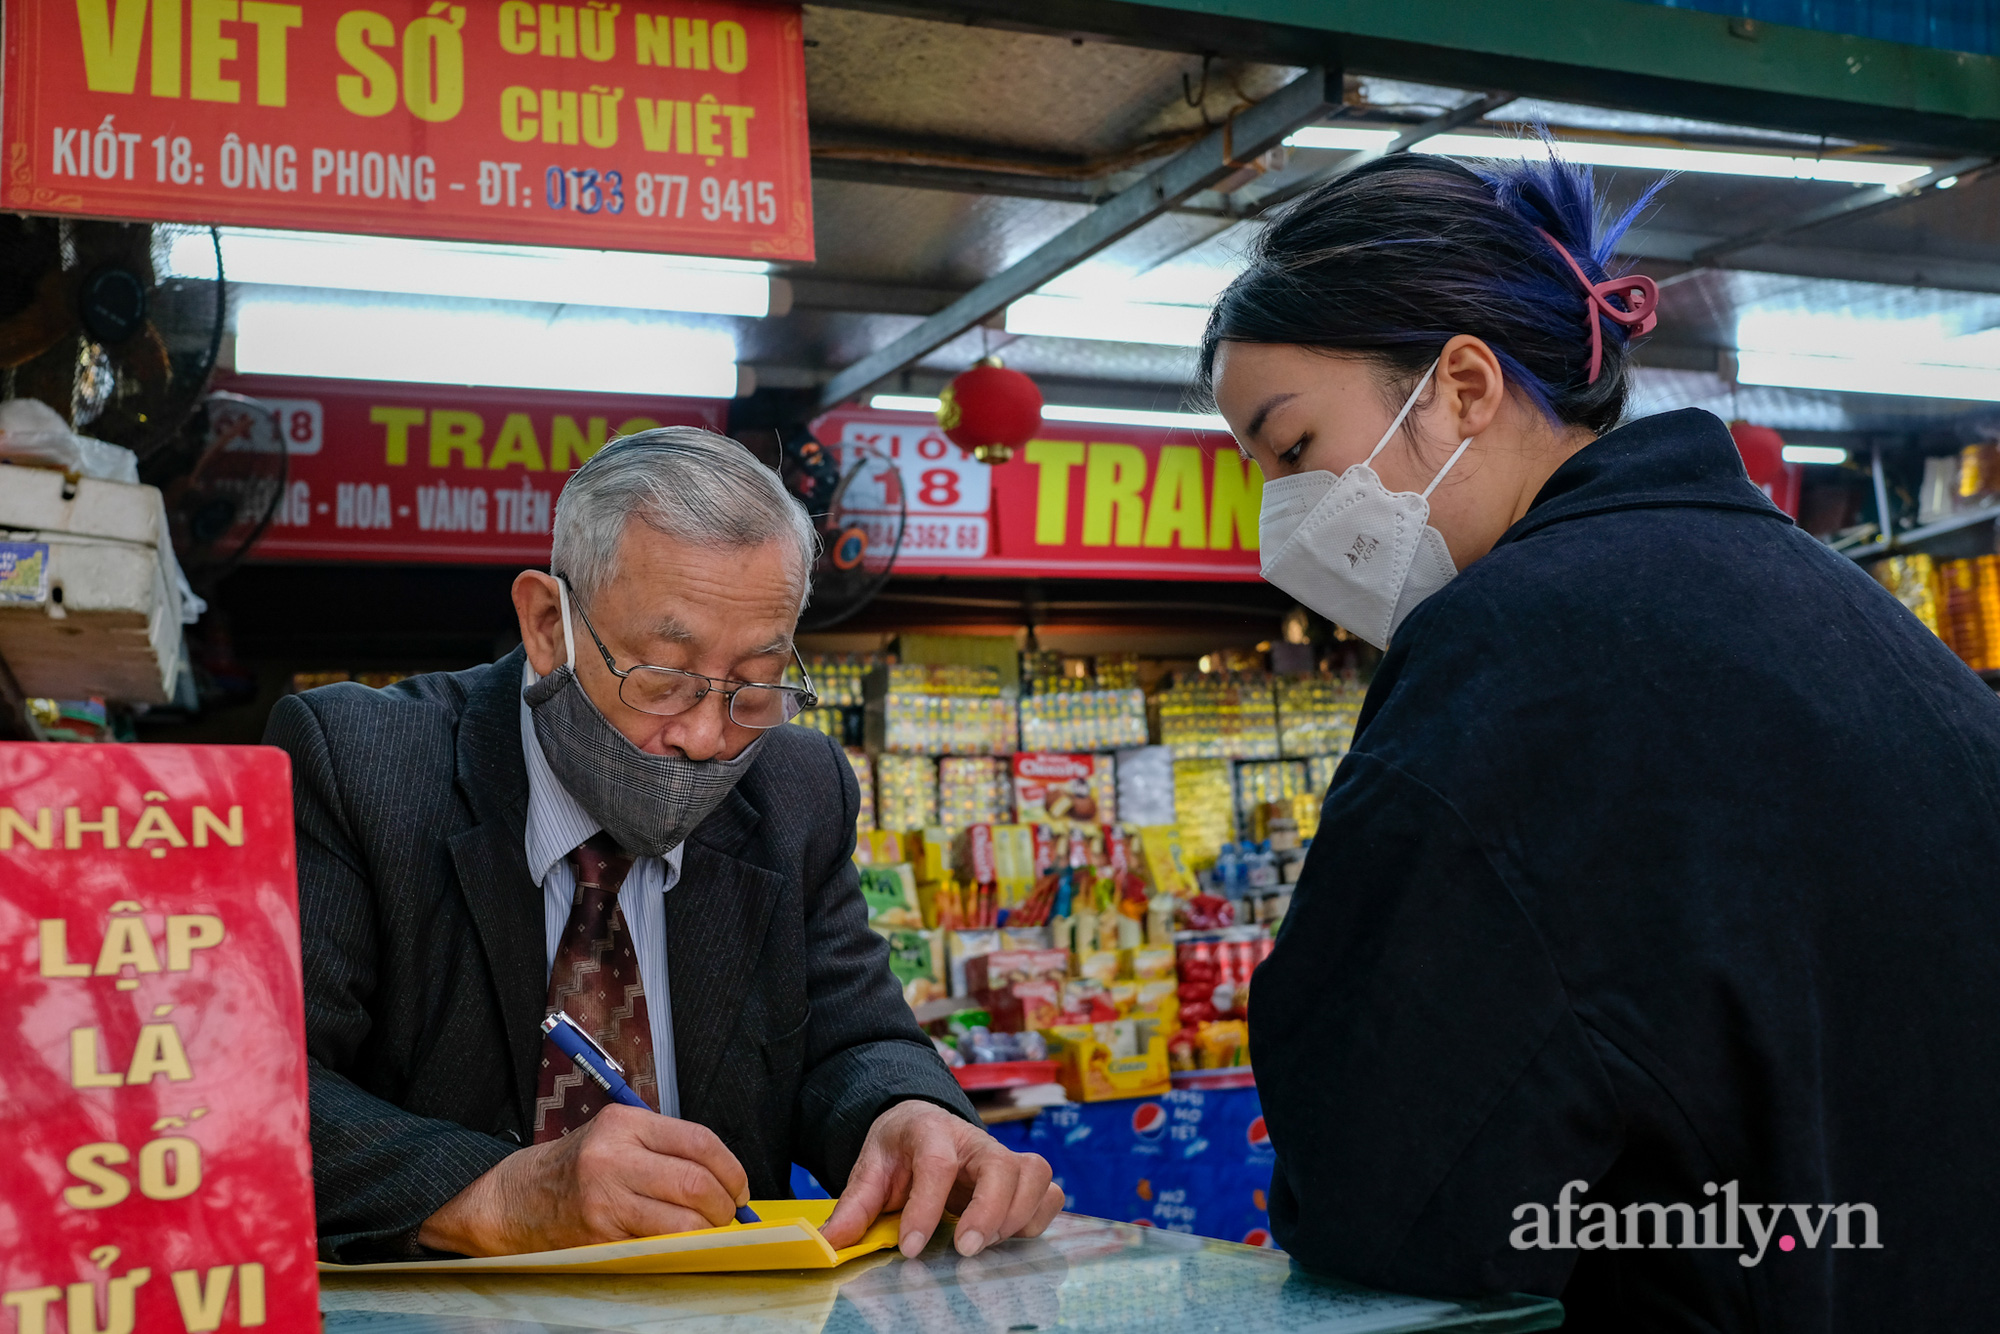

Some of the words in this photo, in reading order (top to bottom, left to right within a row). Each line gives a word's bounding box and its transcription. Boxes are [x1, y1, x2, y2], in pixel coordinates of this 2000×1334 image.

[498, 0, 622, 62] CHỮ
[635, 13, 748, 74] NHO
[500, 85, 624, 149] CHỮ
[635, 93, 755, 167] VIỆT
[52, 114, 142, 180] KIỐT
[151, 135, 204, 185] 18:
[219, 132, 297, 192] ÔNG
[312, 148, 436, 202] PHONG
[477, 160, 531, 208] ĐT:
[635, 171, 689, 219] 877
[700, 176, 777, 225] 9415
[336, 482, 392, 530] HOA
[416, 479, 489, 533] VÀNG
[873, 468, 961, 507] 18
[0, 790, 245, 858] NHẬN
[39, 901, 225, 991] LẬP
[70, 1003, 194, 1089] LÁ
[64, 1107, 208, 1210] SỐ
[171, 1262, 266, 1333] VI
